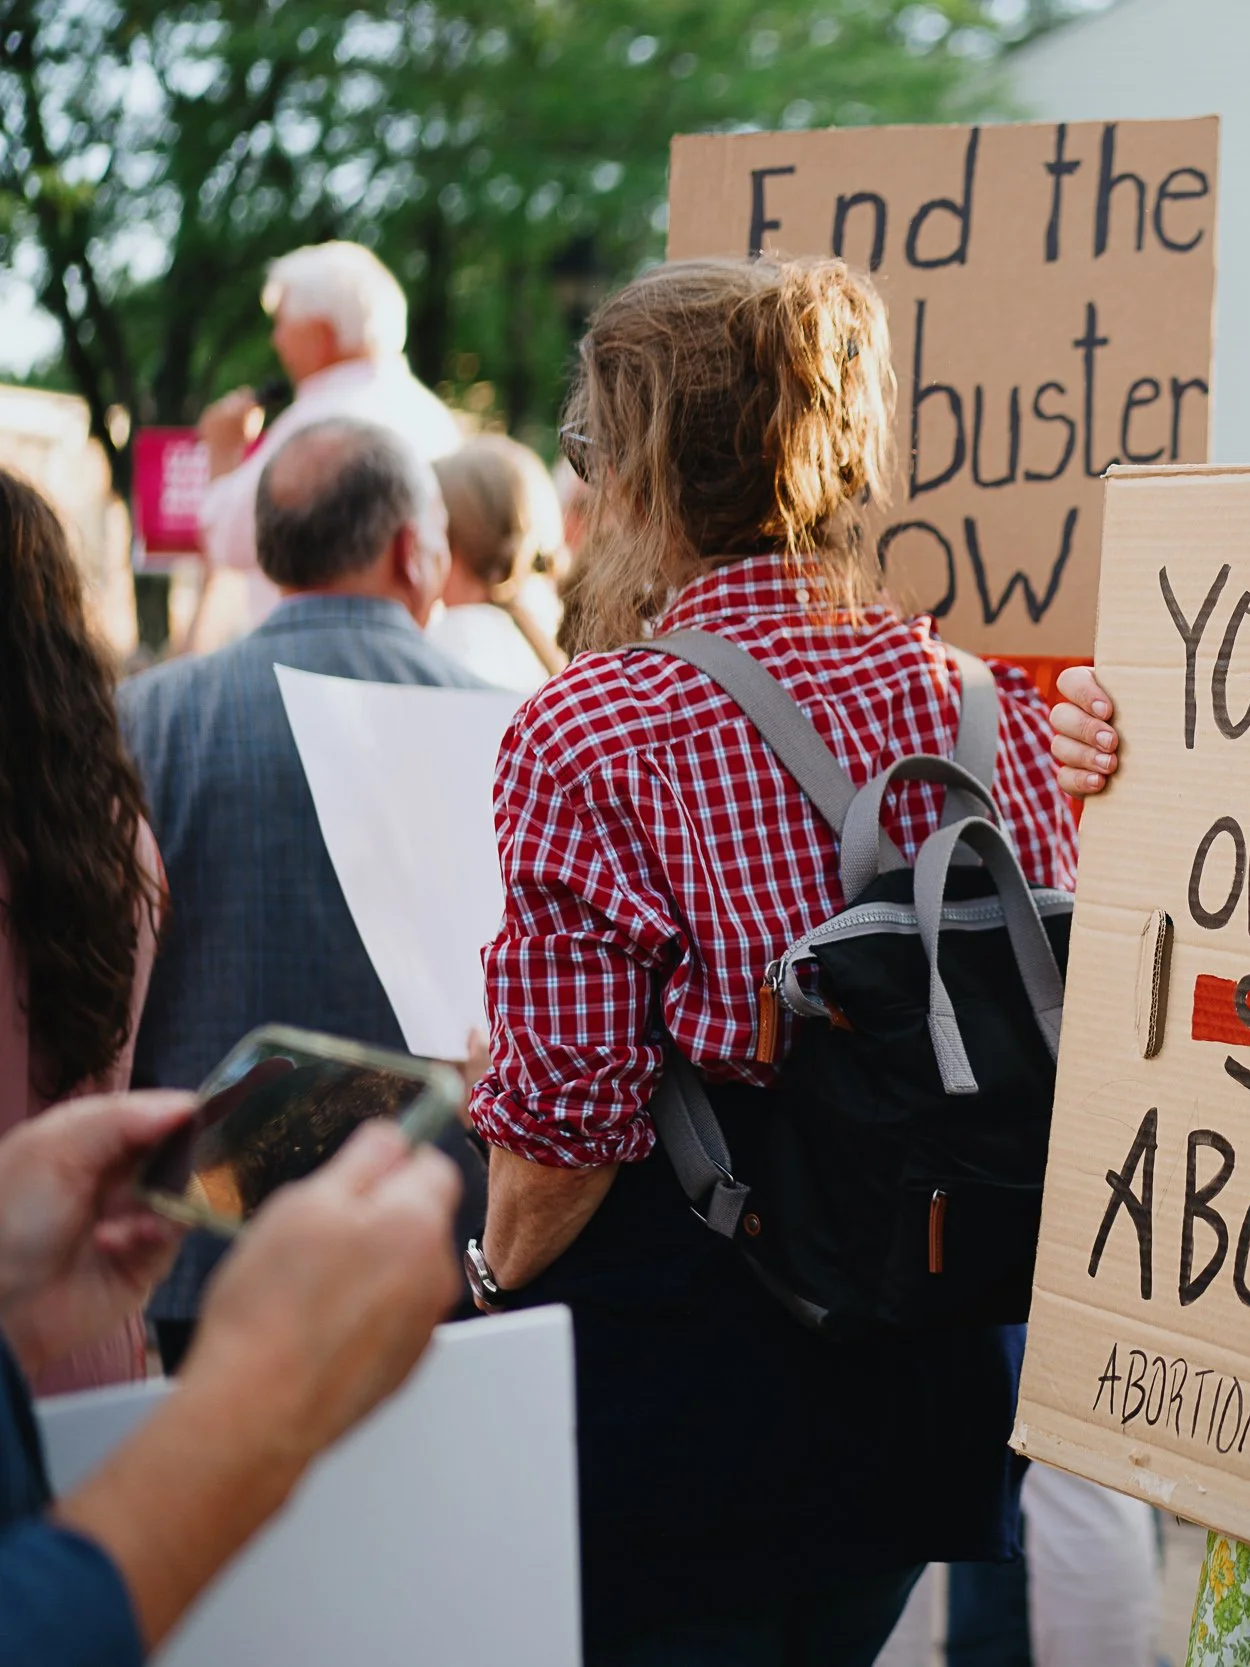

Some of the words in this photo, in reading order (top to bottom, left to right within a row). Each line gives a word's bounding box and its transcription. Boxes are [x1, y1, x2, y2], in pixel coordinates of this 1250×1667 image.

[748, 126, 980, 271] End
[1045, 122, 1209, 263] the
[910, 299, 1209, 500] buster
